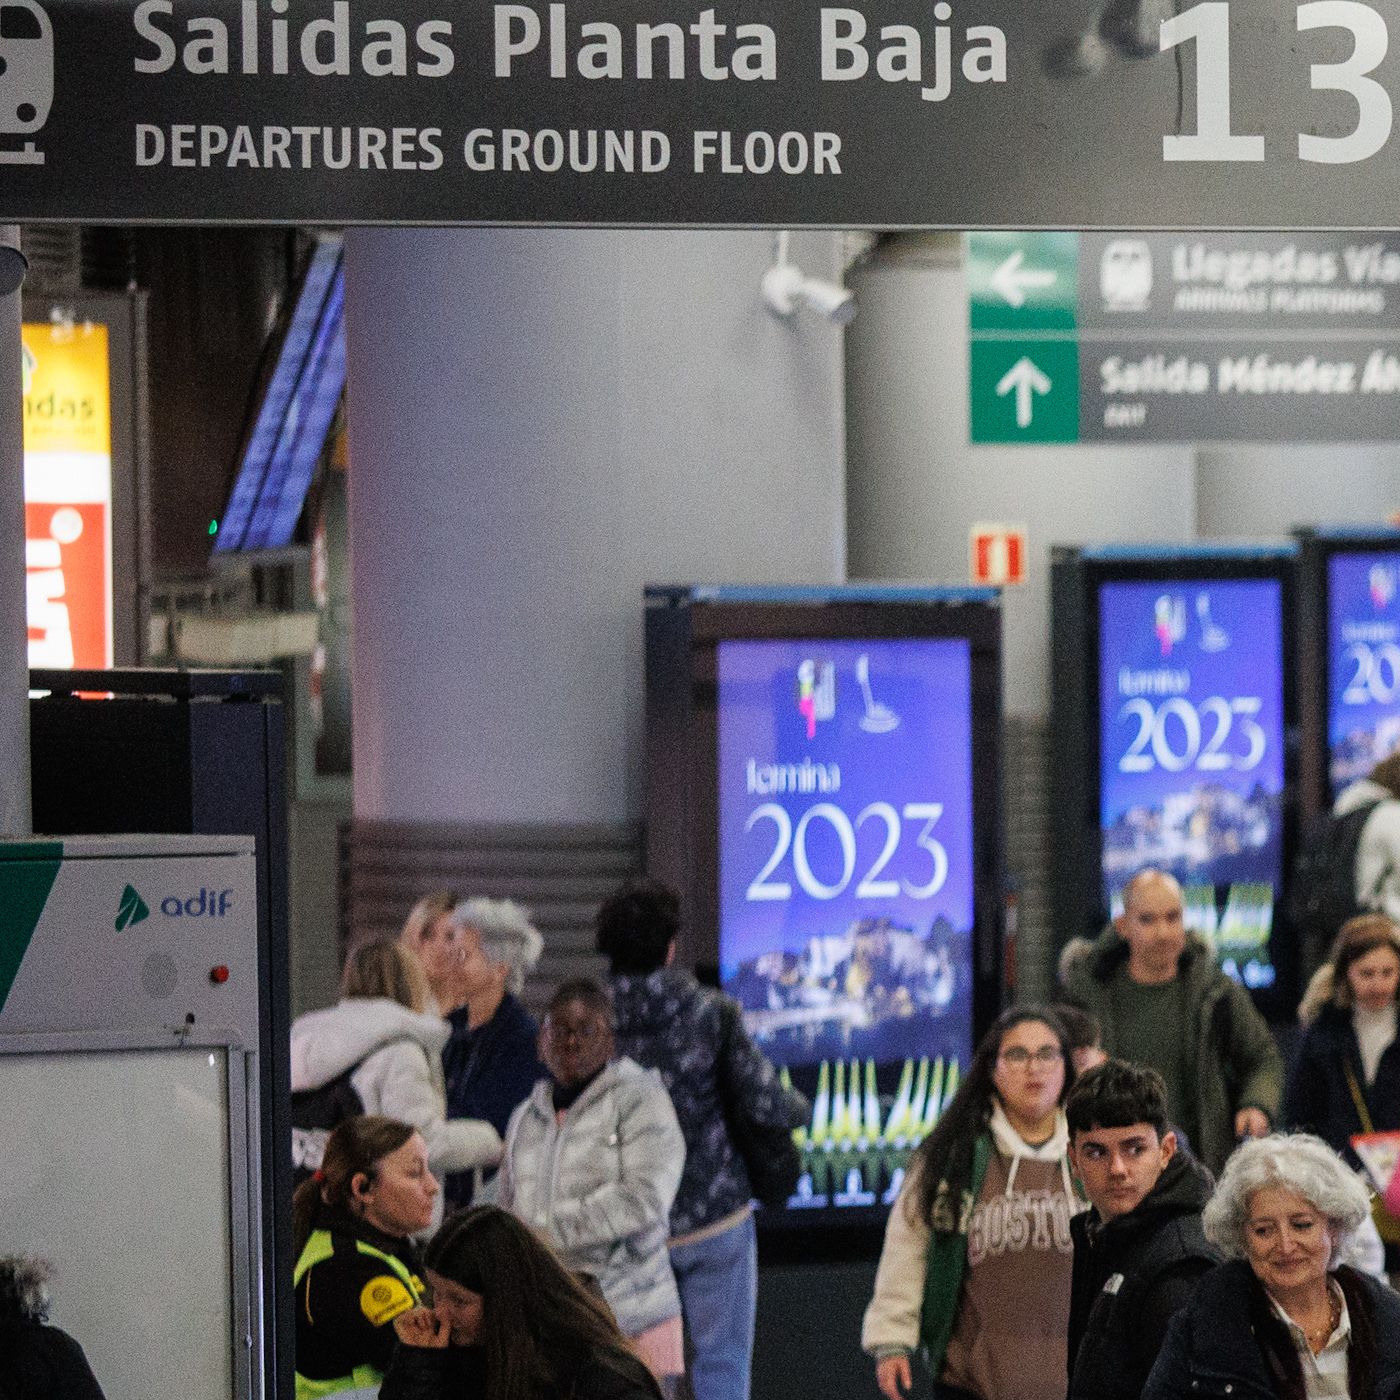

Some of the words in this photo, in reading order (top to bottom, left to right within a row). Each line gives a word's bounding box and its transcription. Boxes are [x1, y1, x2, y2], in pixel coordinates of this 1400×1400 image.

[134, 0, 454, 77] Salidas
[495, 3, 776, 80] Planta
[821, 2, 1007, 101] Baja
[136, 125, 443, 170] DEPARTURES
[464, 128, 670, 172] GROUND
[694, 131, 841, 174] FLOOR
[1172, 243, 1339, 290] Llegadas
[1100, 351, 1209, 394] Salida
[1217, 352, 1354, 394] Méndez
[745, 801, 949, 901] 2023
[160, 888, 234, 918] adif
